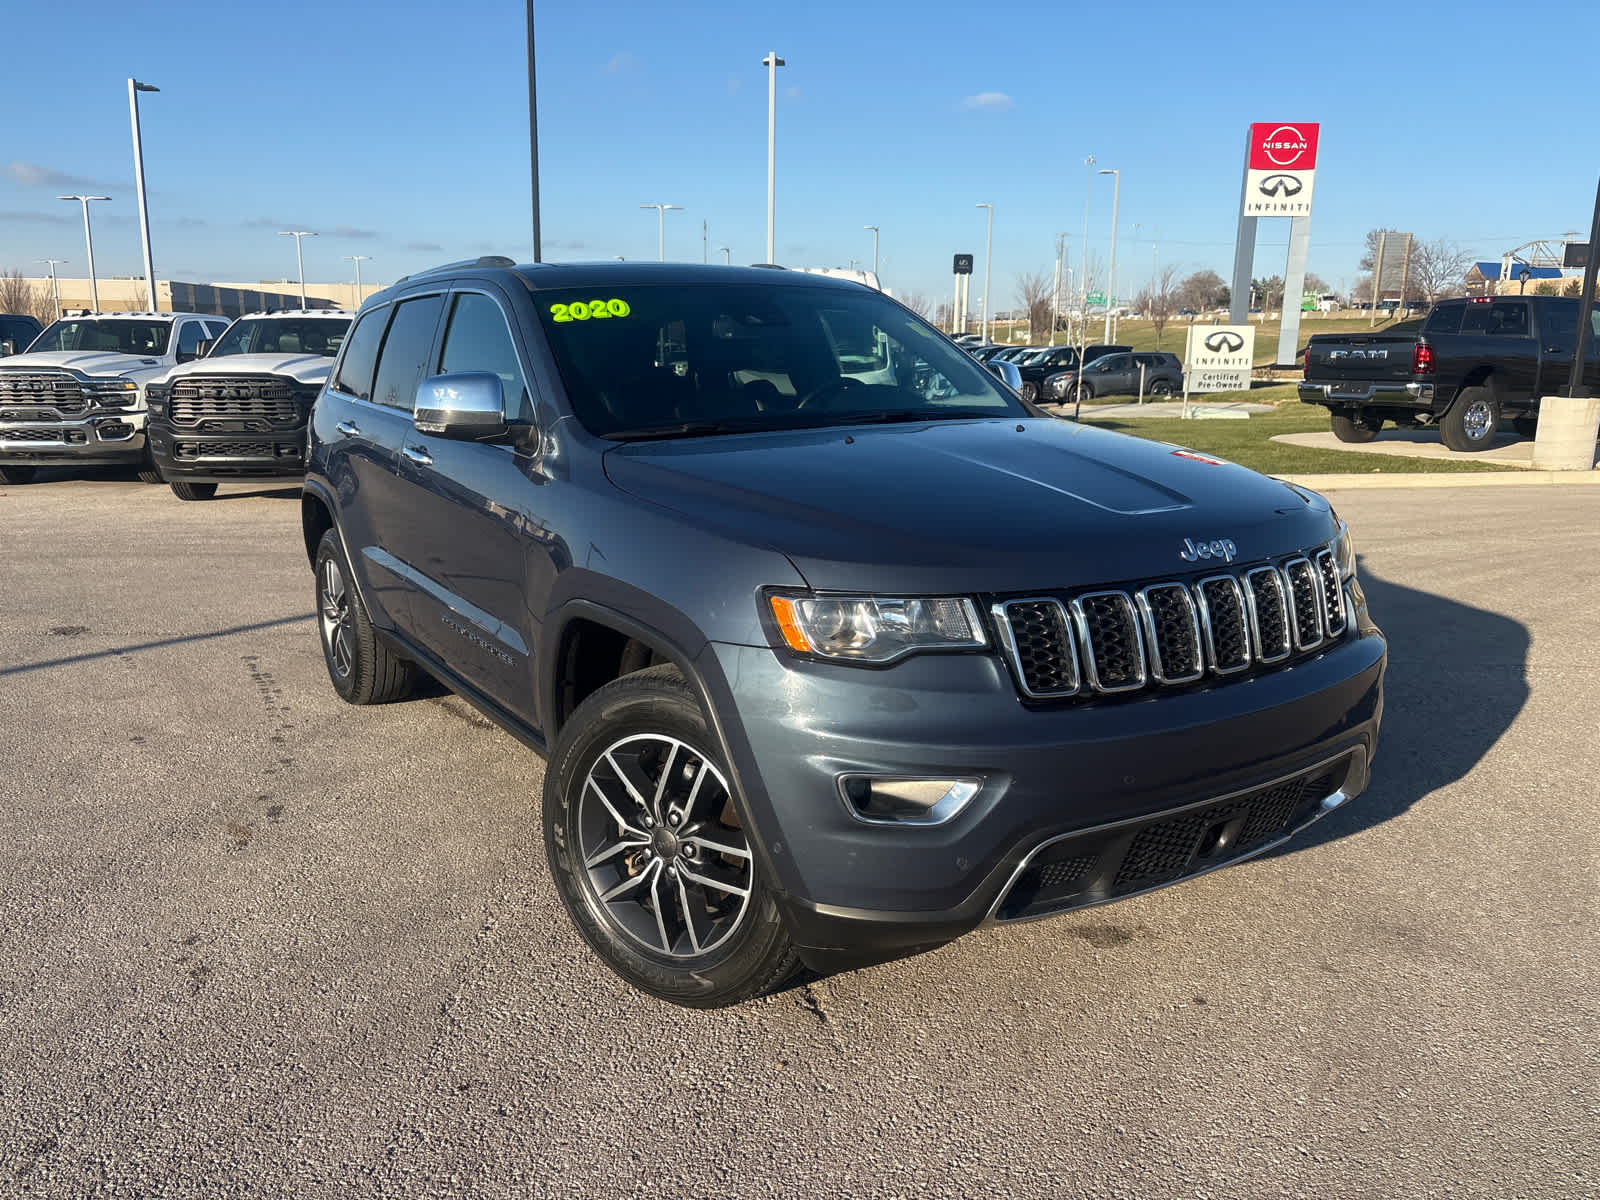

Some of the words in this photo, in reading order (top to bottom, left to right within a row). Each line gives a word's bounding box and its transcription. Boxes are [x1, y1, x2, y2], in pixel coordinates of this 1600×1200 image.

[1248, 203, 1309, 211] INFINITI
[550, 298, 631, 322] 2020
[1330, 350, 1388, 359] RAM
[1202, 373, 1240, 381] Certified
[199, 387, 261, 398] RAM
[1180, 537, 1237, 563] Jeep
